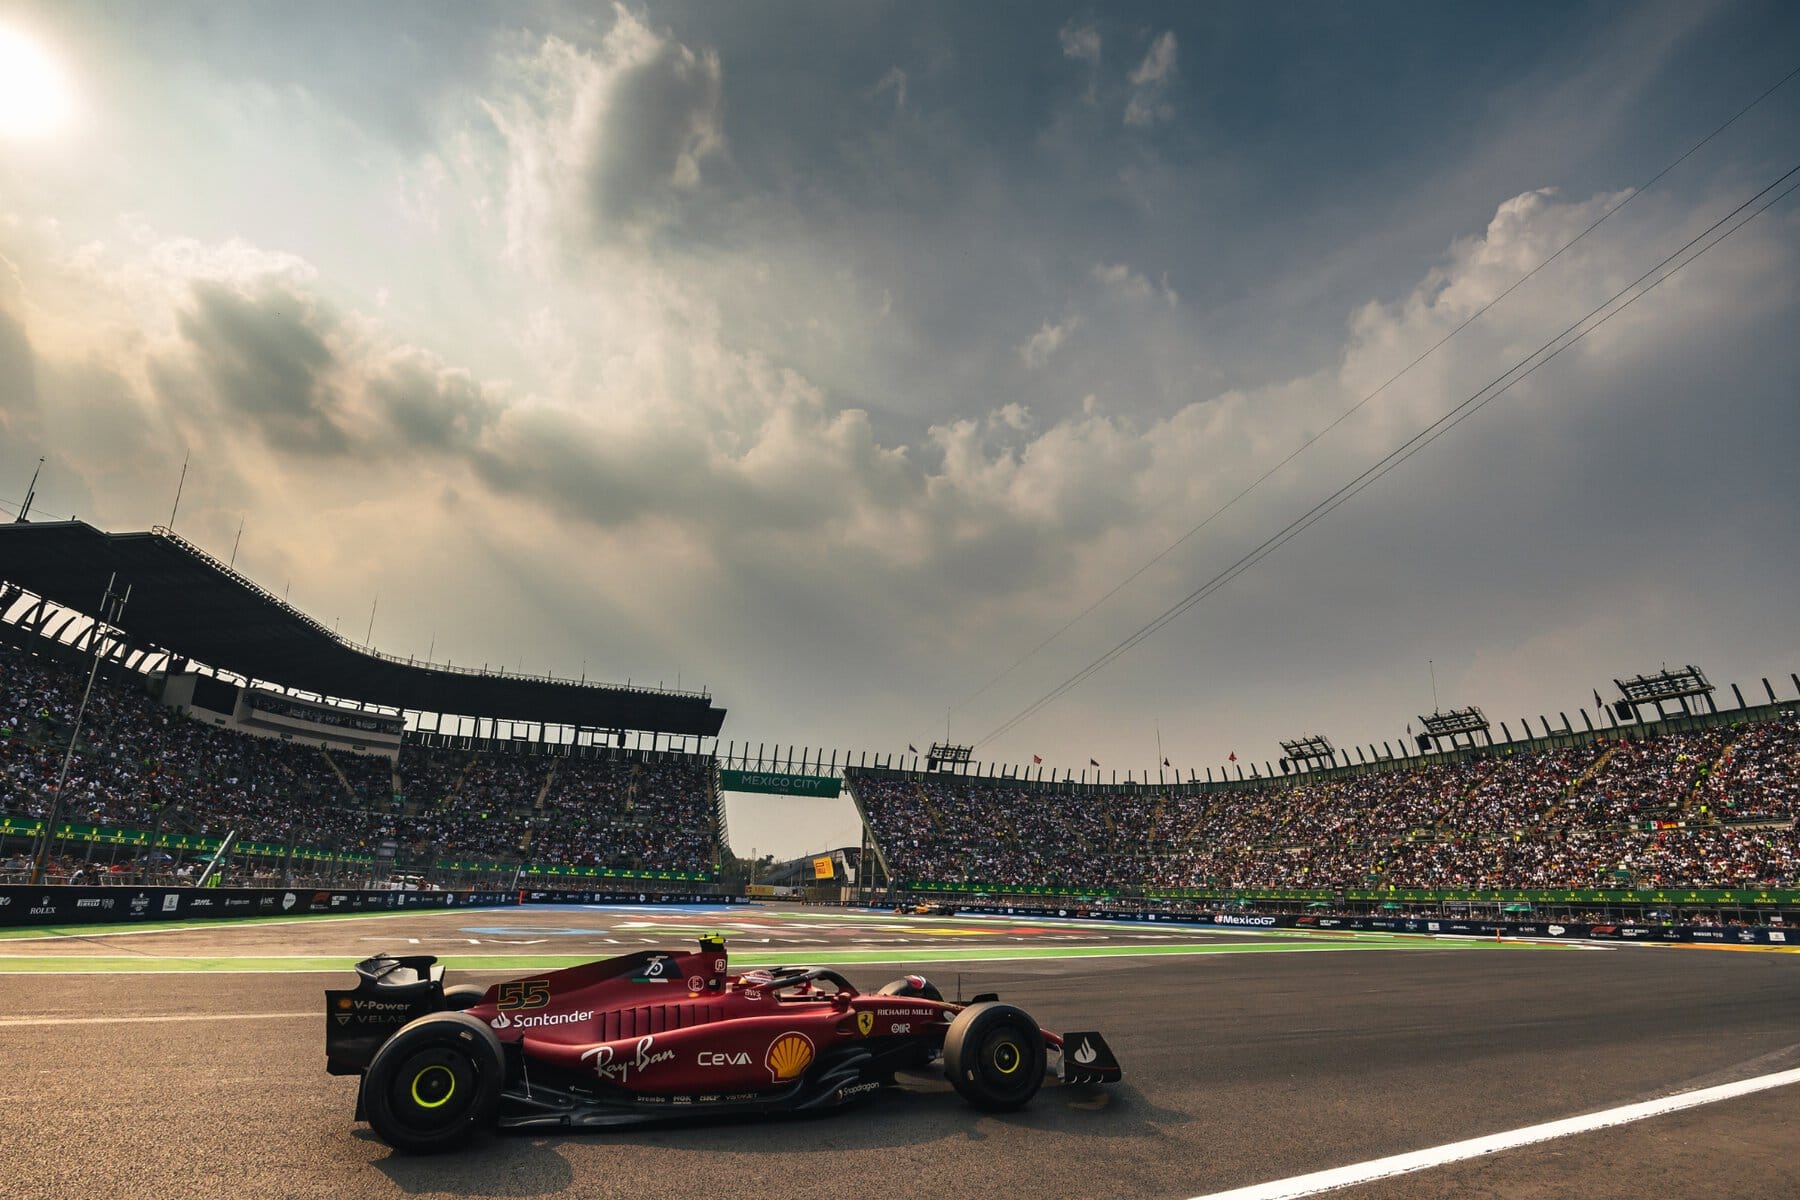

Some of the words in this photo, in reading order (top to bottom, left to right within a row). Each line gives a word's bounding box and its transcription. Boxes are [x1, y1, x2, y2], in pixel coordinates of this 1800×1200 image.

[741, 775, 790, 787] MEXICO
[793, 778, 821, 789] CITY
[30, 906, 56, 915] ROLEX
[497, 979, 550, 1011] 55
[354, 1000, 411, 1010] V-Power
[877, 1008, 910, 1016] RICHARD
[911, 1008, 934, 1016] MILLE
[513, 1010, 595, 1028] Santander
[581, 1035, 676, 1083] Ray-Ban
[843, 1082, 880, 1096] Snapdragon
